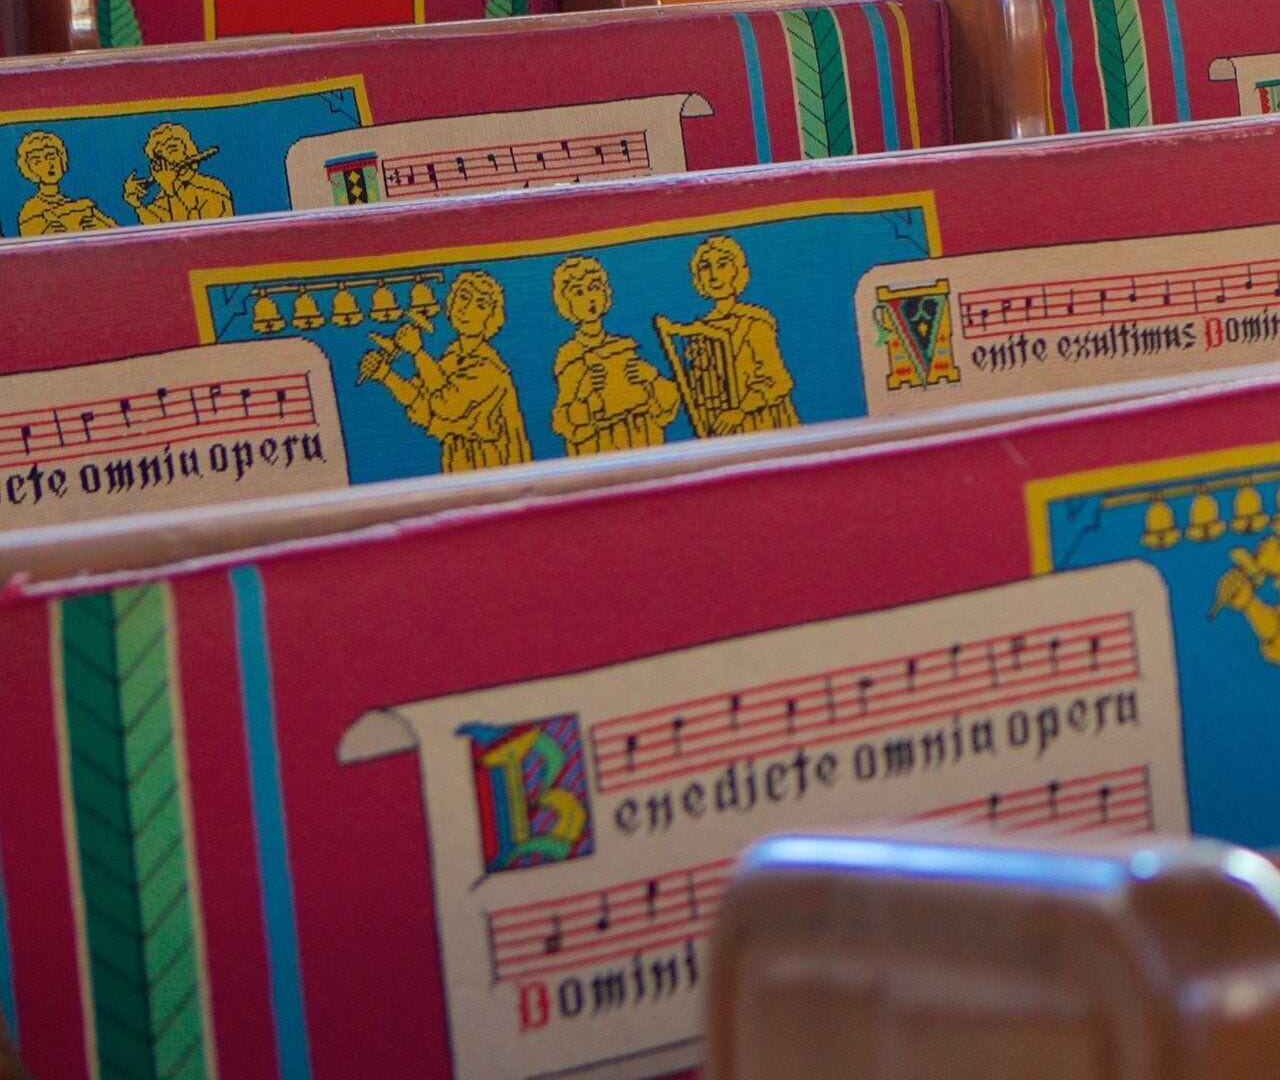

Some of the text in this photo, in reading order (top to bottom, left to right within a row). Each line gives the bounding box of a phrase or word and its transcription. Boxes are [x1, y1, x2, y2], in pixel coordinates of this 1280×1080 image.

[80, 442, 204, 496] omnia
[209, 431, 329, 482] opera
[852, 710, 996, 783] omnia
[1006, 687, 1139, 758] opera
